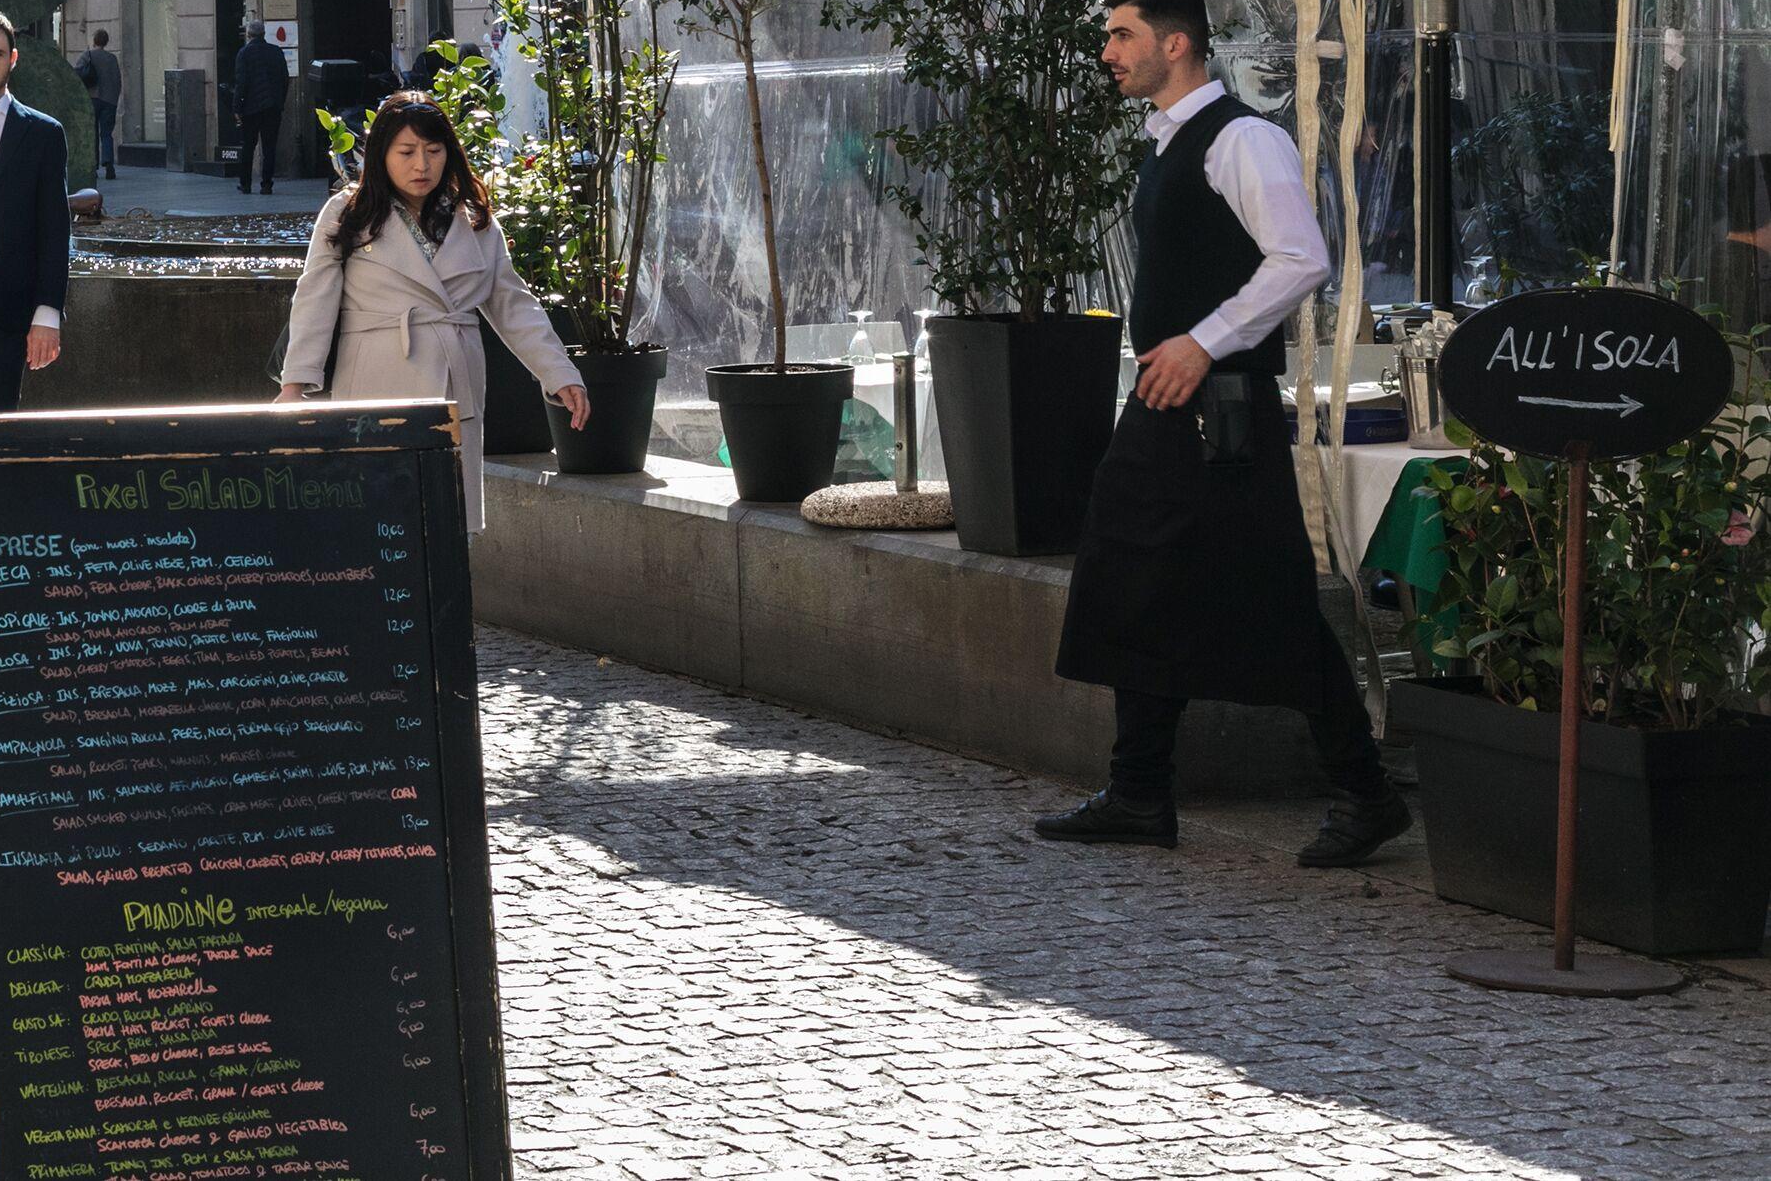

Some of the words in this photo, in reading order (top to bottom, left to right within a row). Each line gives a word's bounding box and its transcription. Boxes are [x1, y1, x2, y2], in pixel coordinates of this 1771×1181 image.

[1485, 324, 1680, 373] ALL'ISOLA
[75, 469, 150, 509] Pixel
[390, 785, 418, 801] CORN
